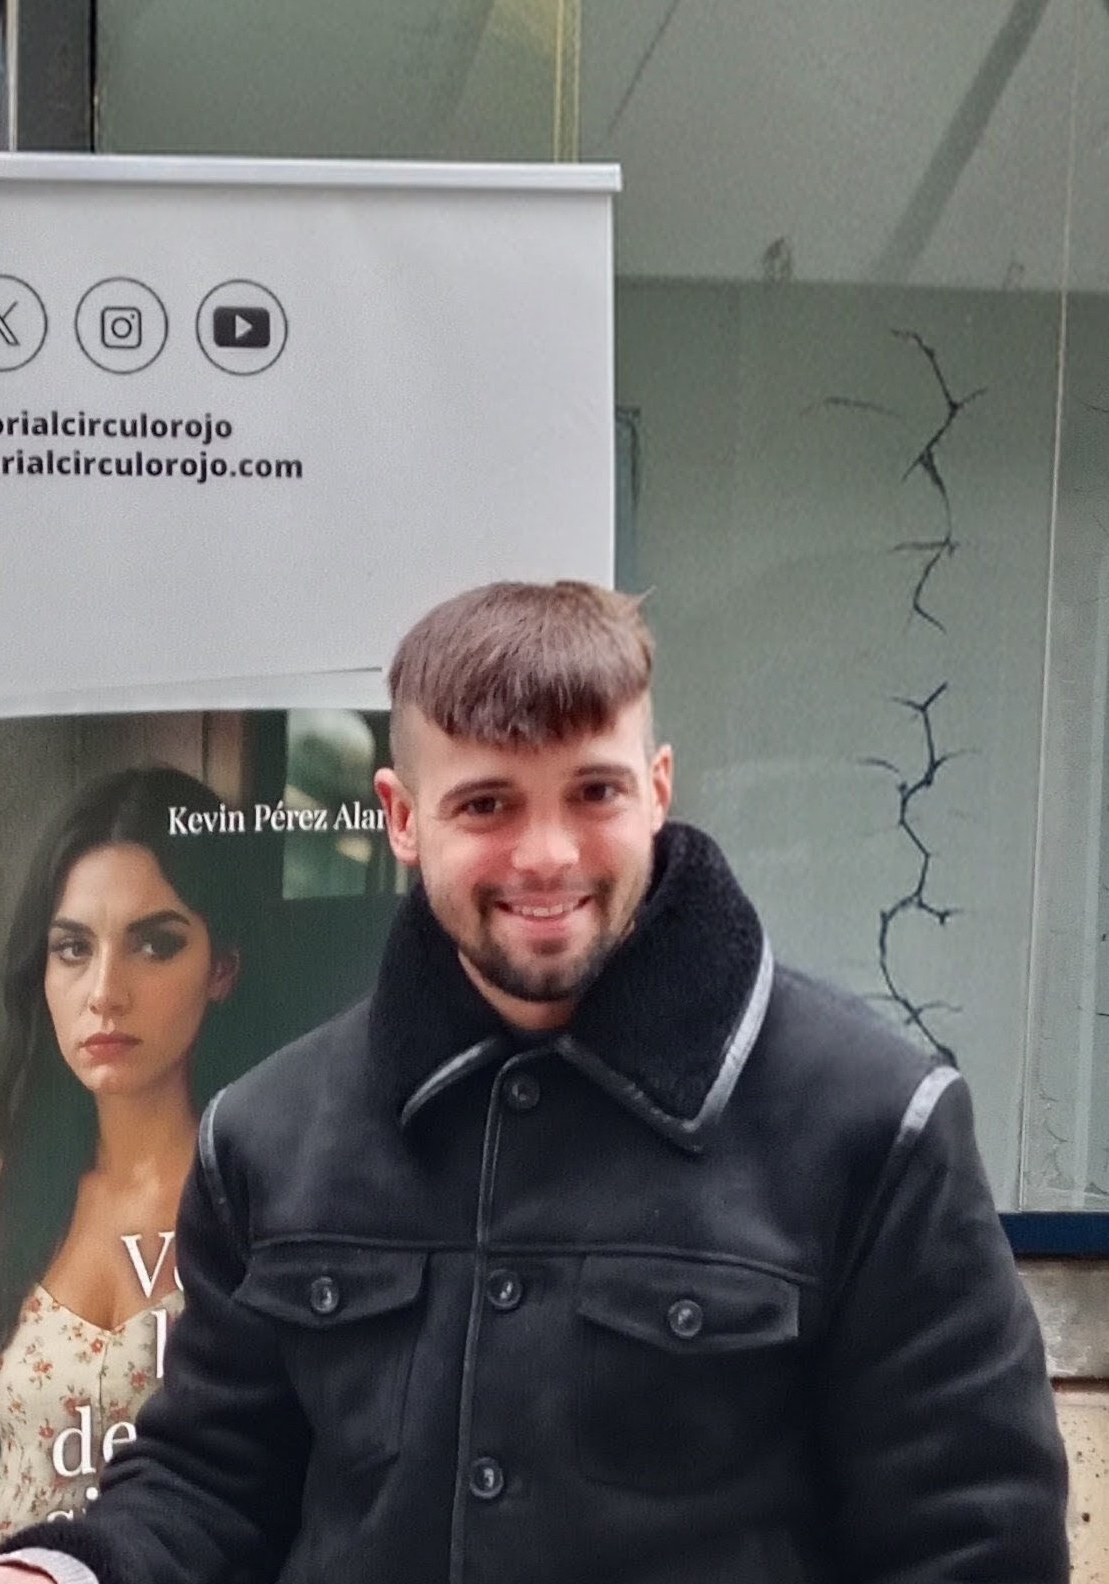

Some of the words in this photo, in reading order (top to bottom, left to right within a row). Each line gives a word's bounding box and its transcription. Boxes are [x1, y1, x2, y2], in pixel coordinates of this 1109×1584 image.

[168, 803, 246, 835] Kevin
[255, 800, 328, 833] Pérez
[121, 1231, 184, 1299] V
[52, 1405, 138, 1478] de
